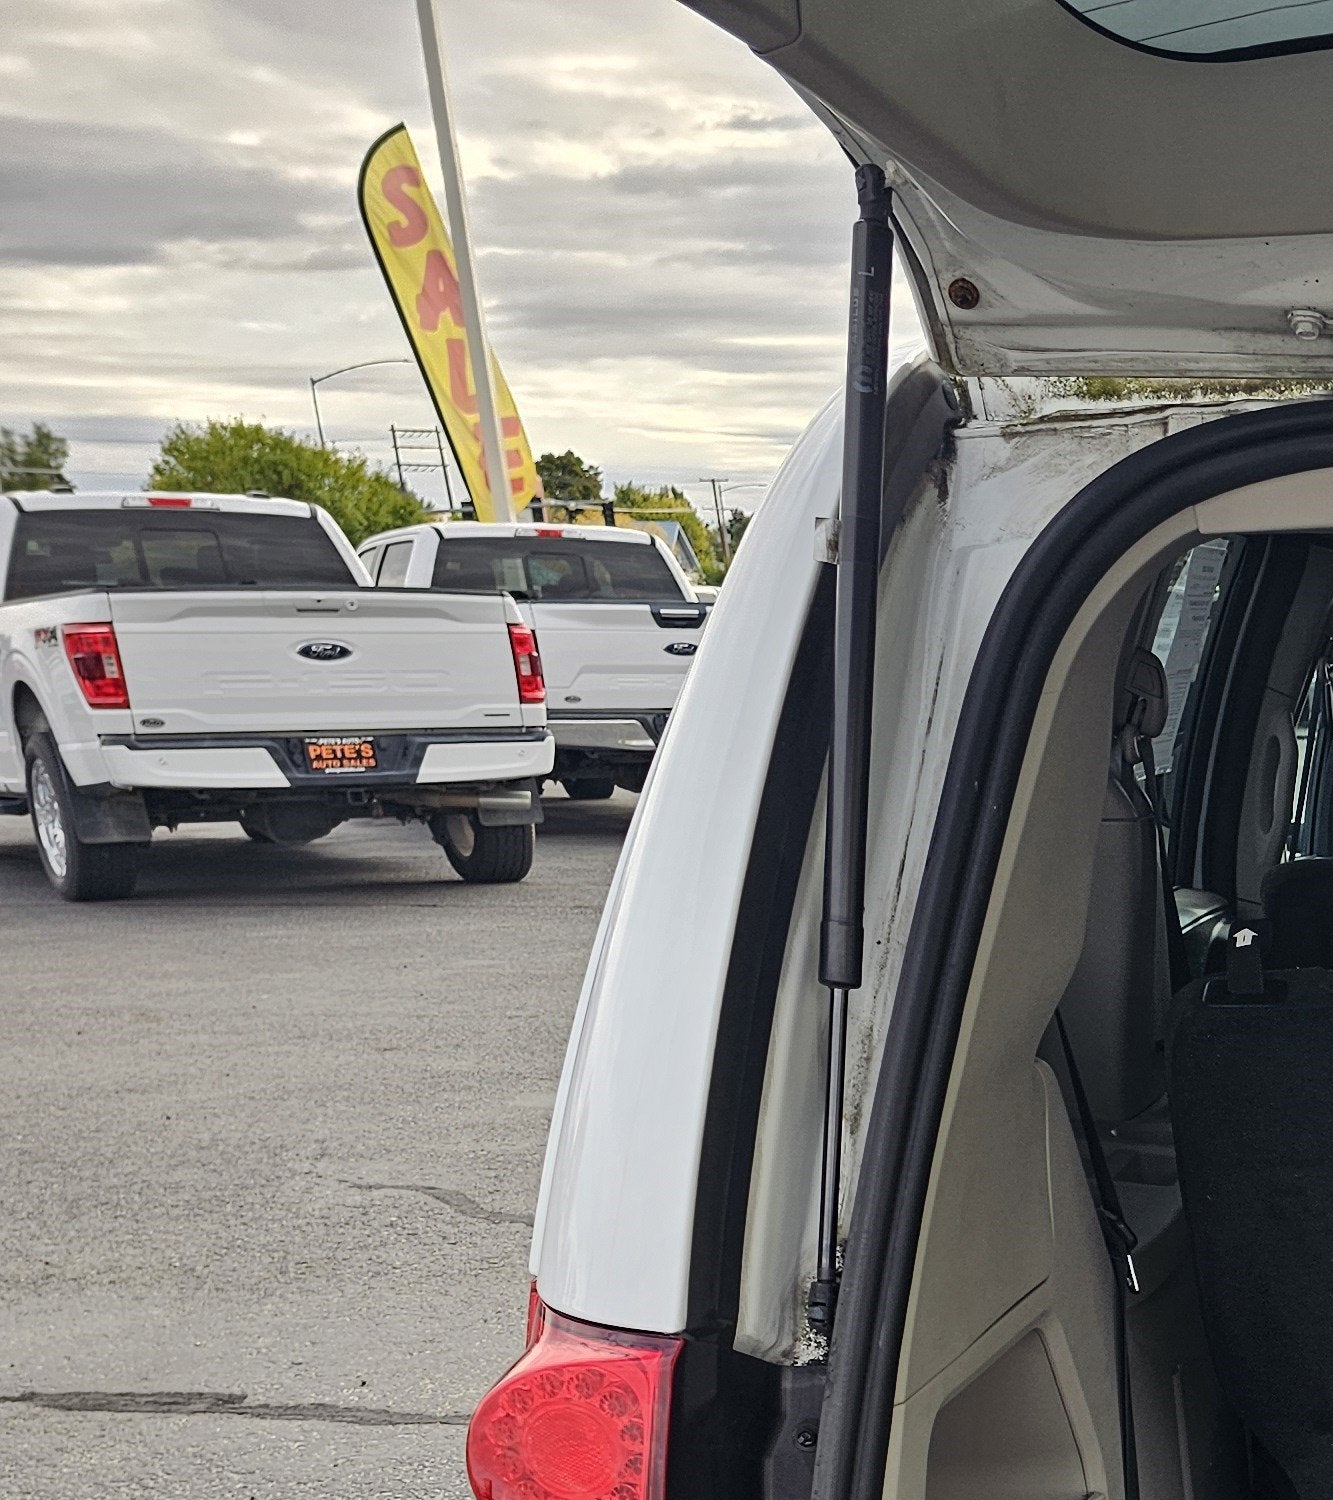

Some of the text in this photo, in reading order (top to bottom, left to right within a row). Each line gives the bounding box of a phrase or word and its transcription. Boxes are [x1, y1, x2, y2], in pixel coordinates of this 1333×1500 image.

[381, 163, 525, 494] SALE
[310, 643, 342, 658] Ford
[308, 743, 374, 759] PETE'S
[312, 758, 376, 769] AUTO SALES
